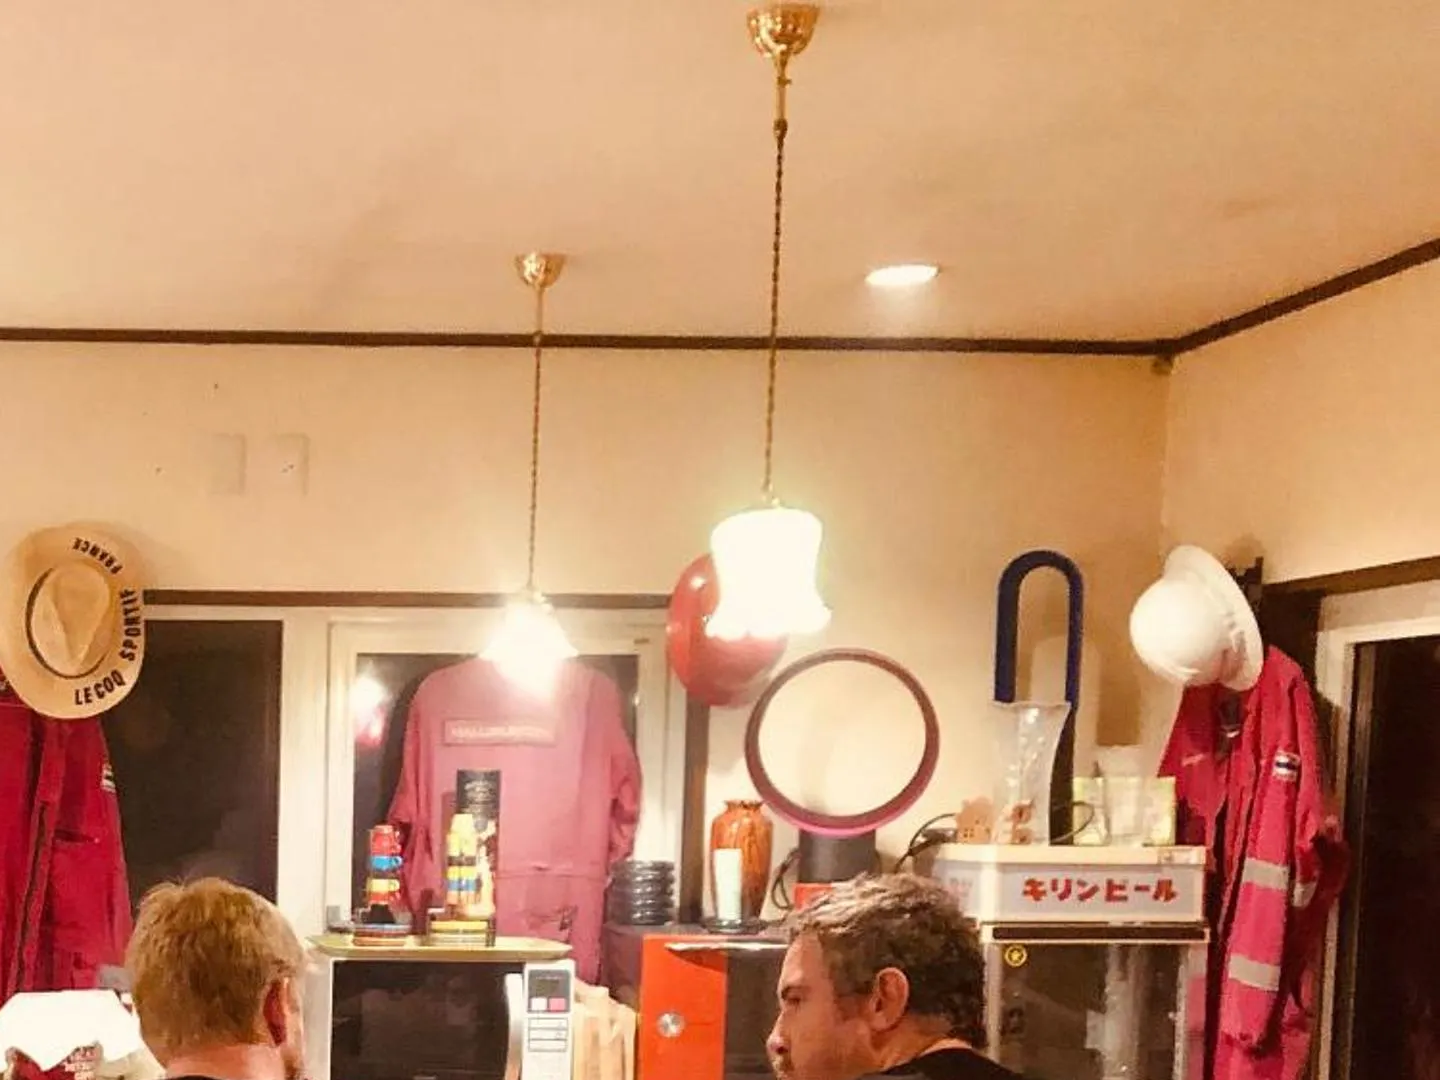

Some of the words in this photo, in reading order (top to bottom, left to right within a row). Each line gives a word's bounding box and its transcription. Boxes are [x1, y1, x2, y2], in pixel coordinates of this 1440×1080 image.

[72, 537, 123, 575] FRANCE
[119, 588, 141, 662] SPORTIF
[1023, 878, 1177, 902] キリンビール
